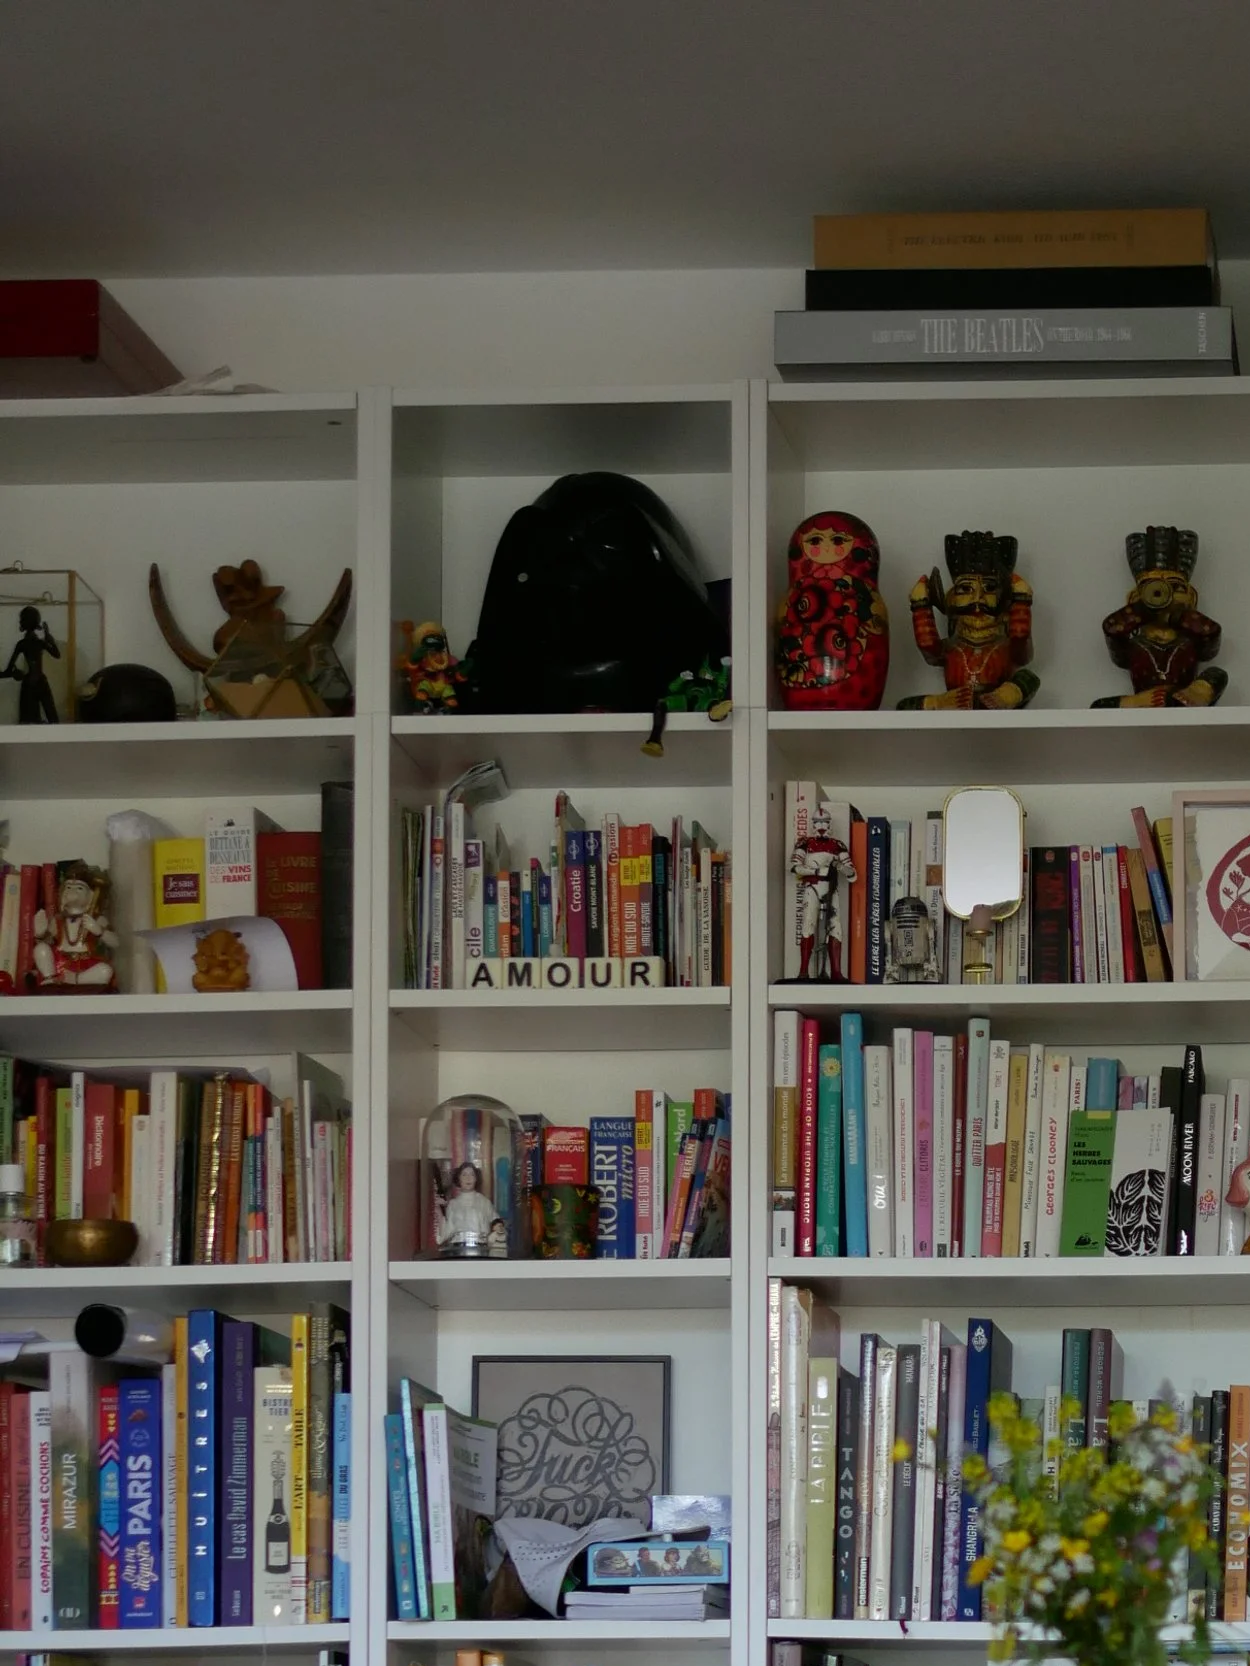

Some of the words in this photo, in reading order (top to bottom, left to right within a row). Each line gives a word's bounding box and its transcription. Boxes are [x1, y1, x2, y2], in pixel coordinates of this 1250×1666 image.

[920, 318, 958, 354] THE
[964, 317, 1044, 354] BEATLES
[222, 874, 252, 884] FRANCE
[228, 865, 252, 874] VINS
[569, 869, 582, 912] Croatie
[622, 902, 638, 918] SUD
[622, 919, 638, 932] DU
[622, 934, 638, 954] INDE
[471, 961, 652, 988] AMOUR
[95, 1115, 104, 1166] Dictionnaire
[594, 1122, 634, 1132] LANGUE
[972, 1117, 982, 1138] PARIS
[1183, 1122, 1194, 1150] RIVER
[681, 1143, 696, 1178] BERLIN
[972, 1140, 984, 1166] QUITTER
[1072, 1158, 1112, 1168] SAUVAGES
[1073, 1150, 1100, 1158] HERBES
[638, 1167, 650, 1184] SUD
[1183, 1151, 1194, 1186] MOON
[593, 1142, 618, 1242] ROBERT
[619, 1145, 634, 1200] micro
[638, 1185, 650, 1200] DU
[638, 1202, 650, 1218] INDE
[906, 1355, 914, 1382] MANARA
[294, 1408, 304, 1450] TABLE
[224, 1416, 248, 1486] Zimmerman
[39, 1440, 50, 1494] COCHONS
[62, 1452, 78, 1530] MIRAZUR
[127, 1454, 152, 1536] PARIS
[294, 1475, 304, 1510] L'ART
[840, 1446, 854, 1538] TANGO
[15, 1482, 30, 1552] CUISINE
[224, 1488, 248, 1522] David
[948, 1499, 960, 1514] La
[1228, 1441, 1248, 1570] ECONOMIX
[228, 1523, 248, 1546] cas
[965, 1506, 978, 1562] SHANGRI-LA
[225, 1546, 246, 1560] Le
[16, 1557, 30, 1580] EN
[859, 1556, 870, 1606] casterman
